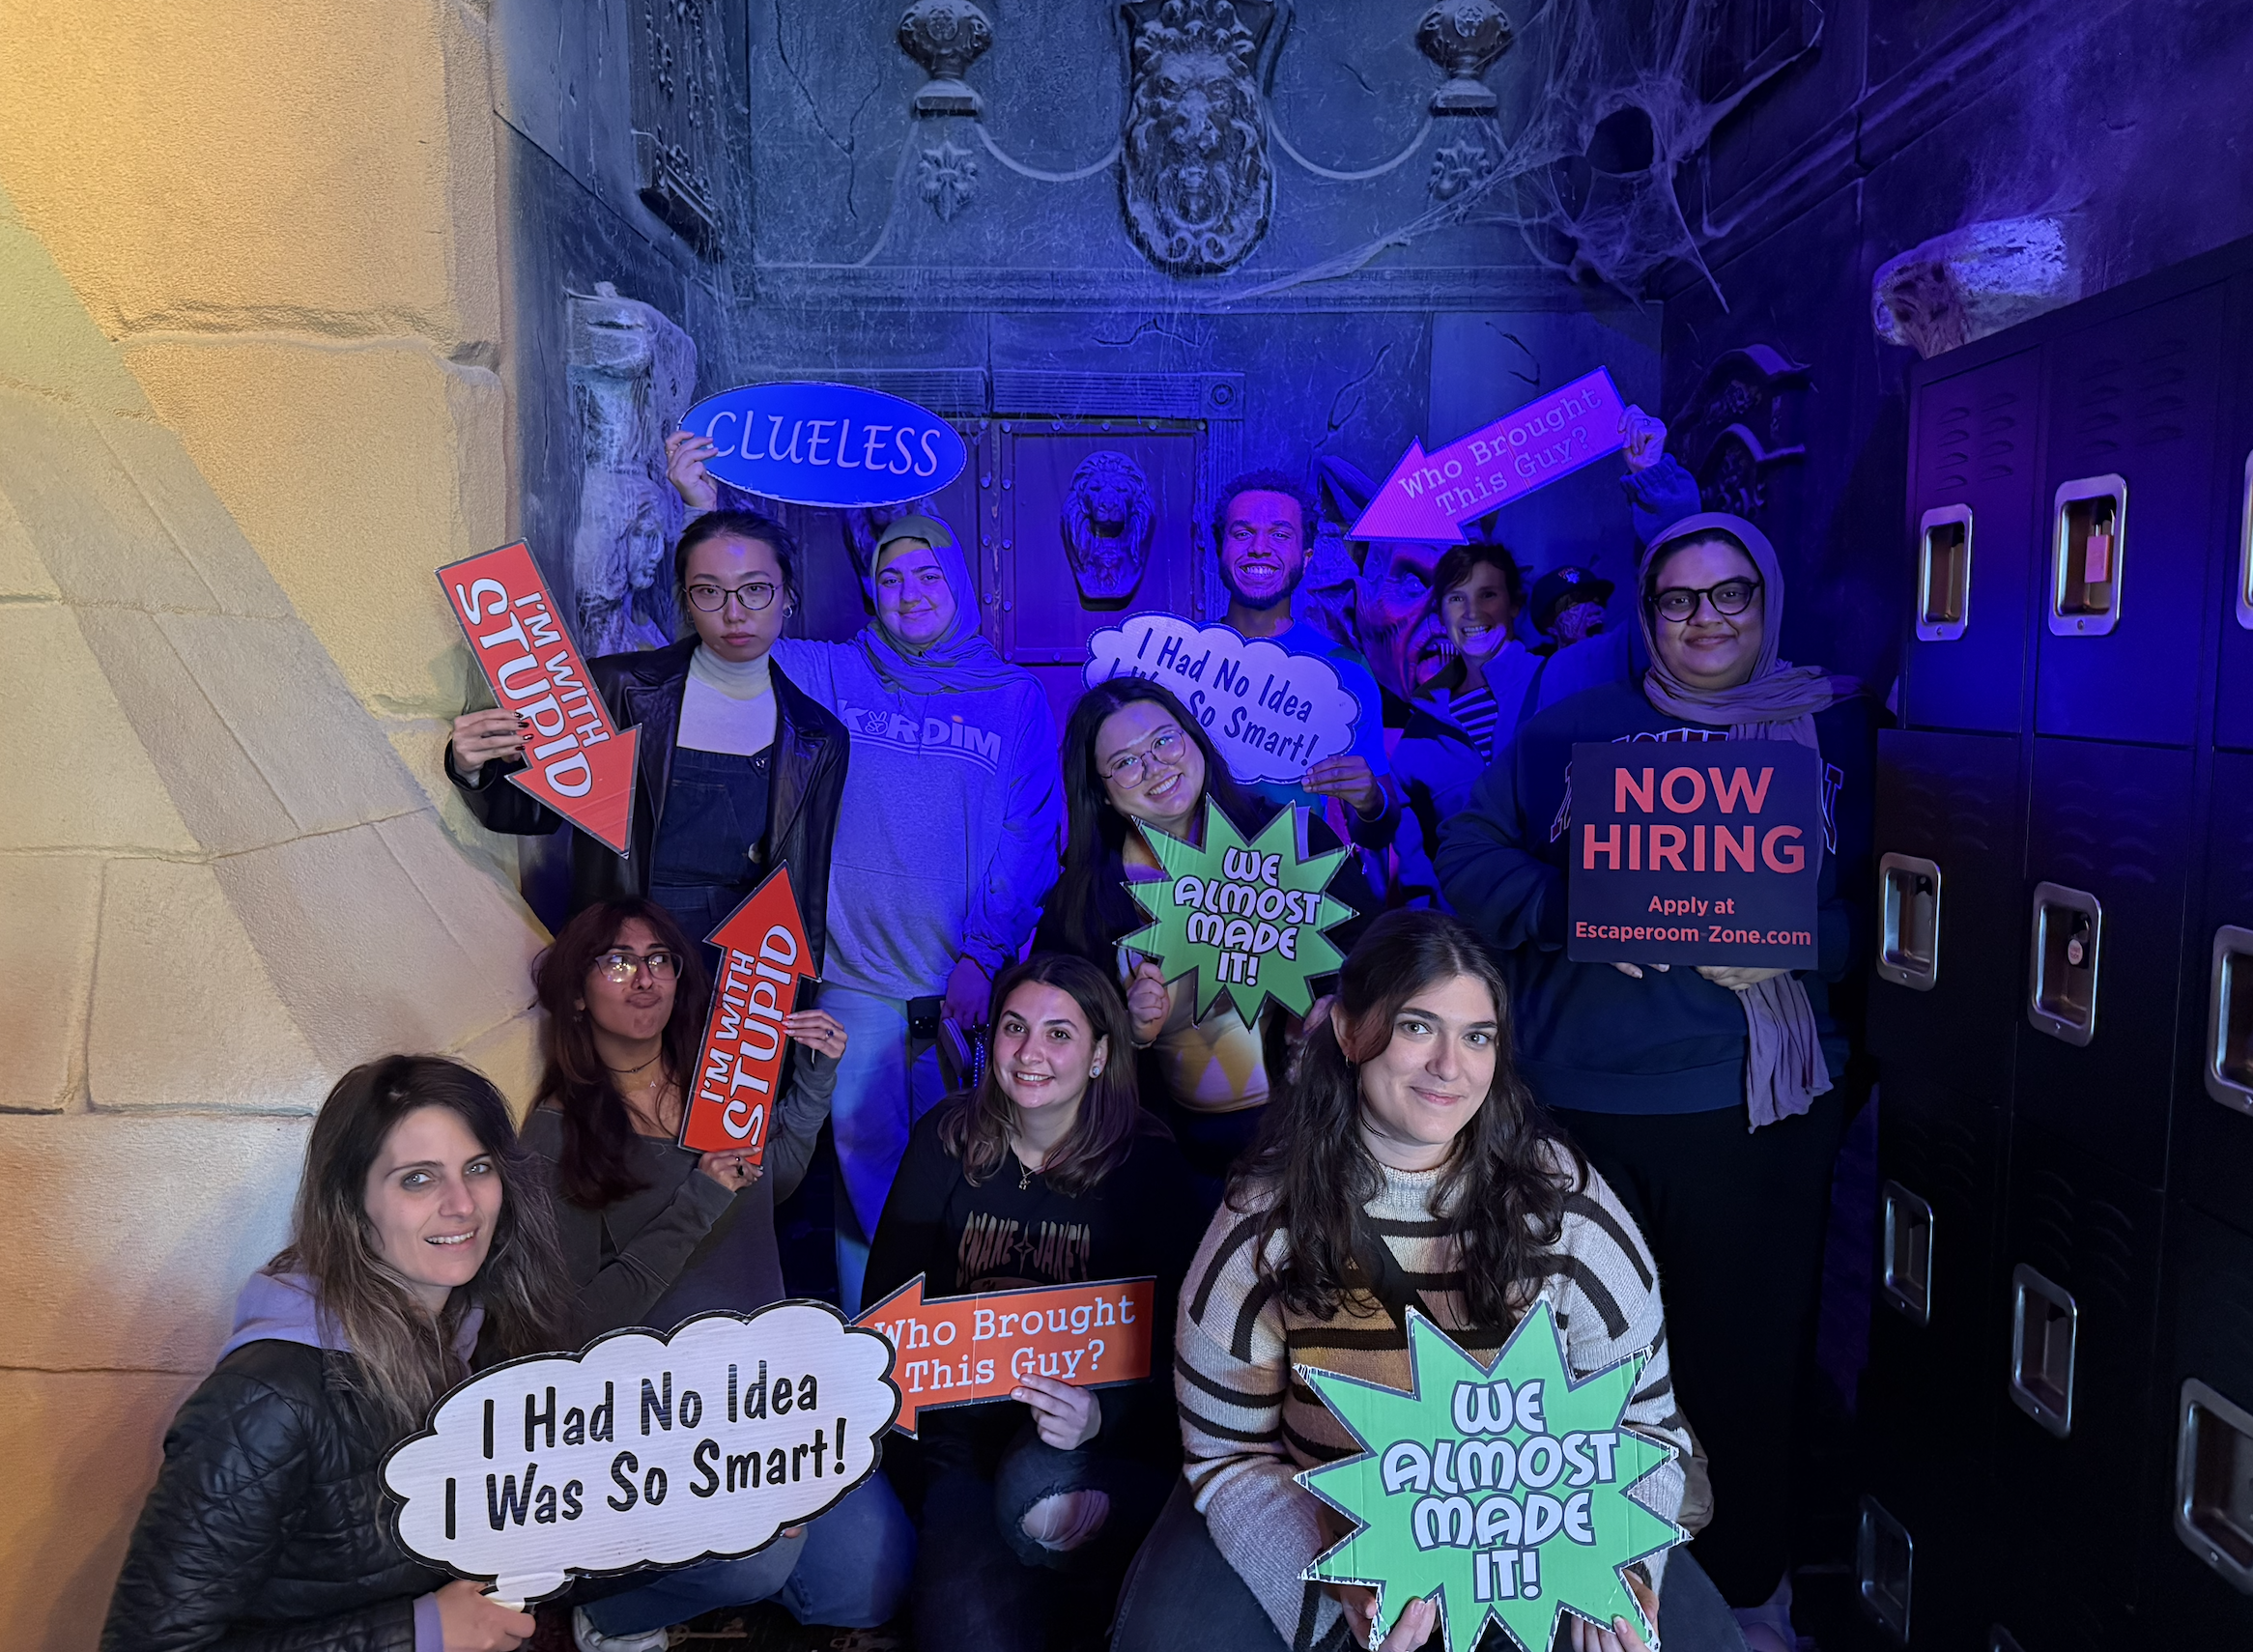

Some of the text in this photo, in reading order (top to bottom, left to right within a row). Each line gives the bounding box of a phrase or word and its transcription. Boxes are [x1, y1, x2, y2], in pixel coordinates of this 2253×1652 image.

[707, 410, 942, 477] CLUELESS
[1398, 387, 1603, 499] Who Brought
[1435, 426, 1589, 517] This Guy?
[455, 578, 593, 798] STUPID
[514, 592, 611, 748] I'M WITH
[1137, 627, 1154, 659] I
[1156, 636, 1211, 682] Had
[1212, 658, 1249, 698] No
[1258, 673, 1312, 723] Idea
[1189, 690, 1216, 727] So
[1224, 706, 1319, 766] Smart!
[1614, 767, 1774, 813] NOW
[1222, 846, 1282, 887] WE
[1583, 824, 1805, 874] HIRING
[1174, 874, 1322, 925] ALMOST
[1648, 896, 1735, 917] Apply at
[1186, 912, 1298, 960] MADE
[1216, 951, 1259, 986] IT!
[699, 949, 756, 1104] I'M WITH
[722, 925, 798, 1146] STUPID
[955, 1211, 1019, 1289] SNAKE
[874, 1295, 1136, 1351] Who Brought
[905, 1339, 1105, 1393] This Guy?
[483, 1360, 817, 1459] I Had No Idea
[1453, 1380, 1546, 1435] WE
[444, 1417, 847, 1540] I Was So Smart!
[1382, 1432, 1619, 1495] ALMOST
[1412, 1490, 1595, 1551] MADE
[1474, 1548, 1543, 1602] IT!
